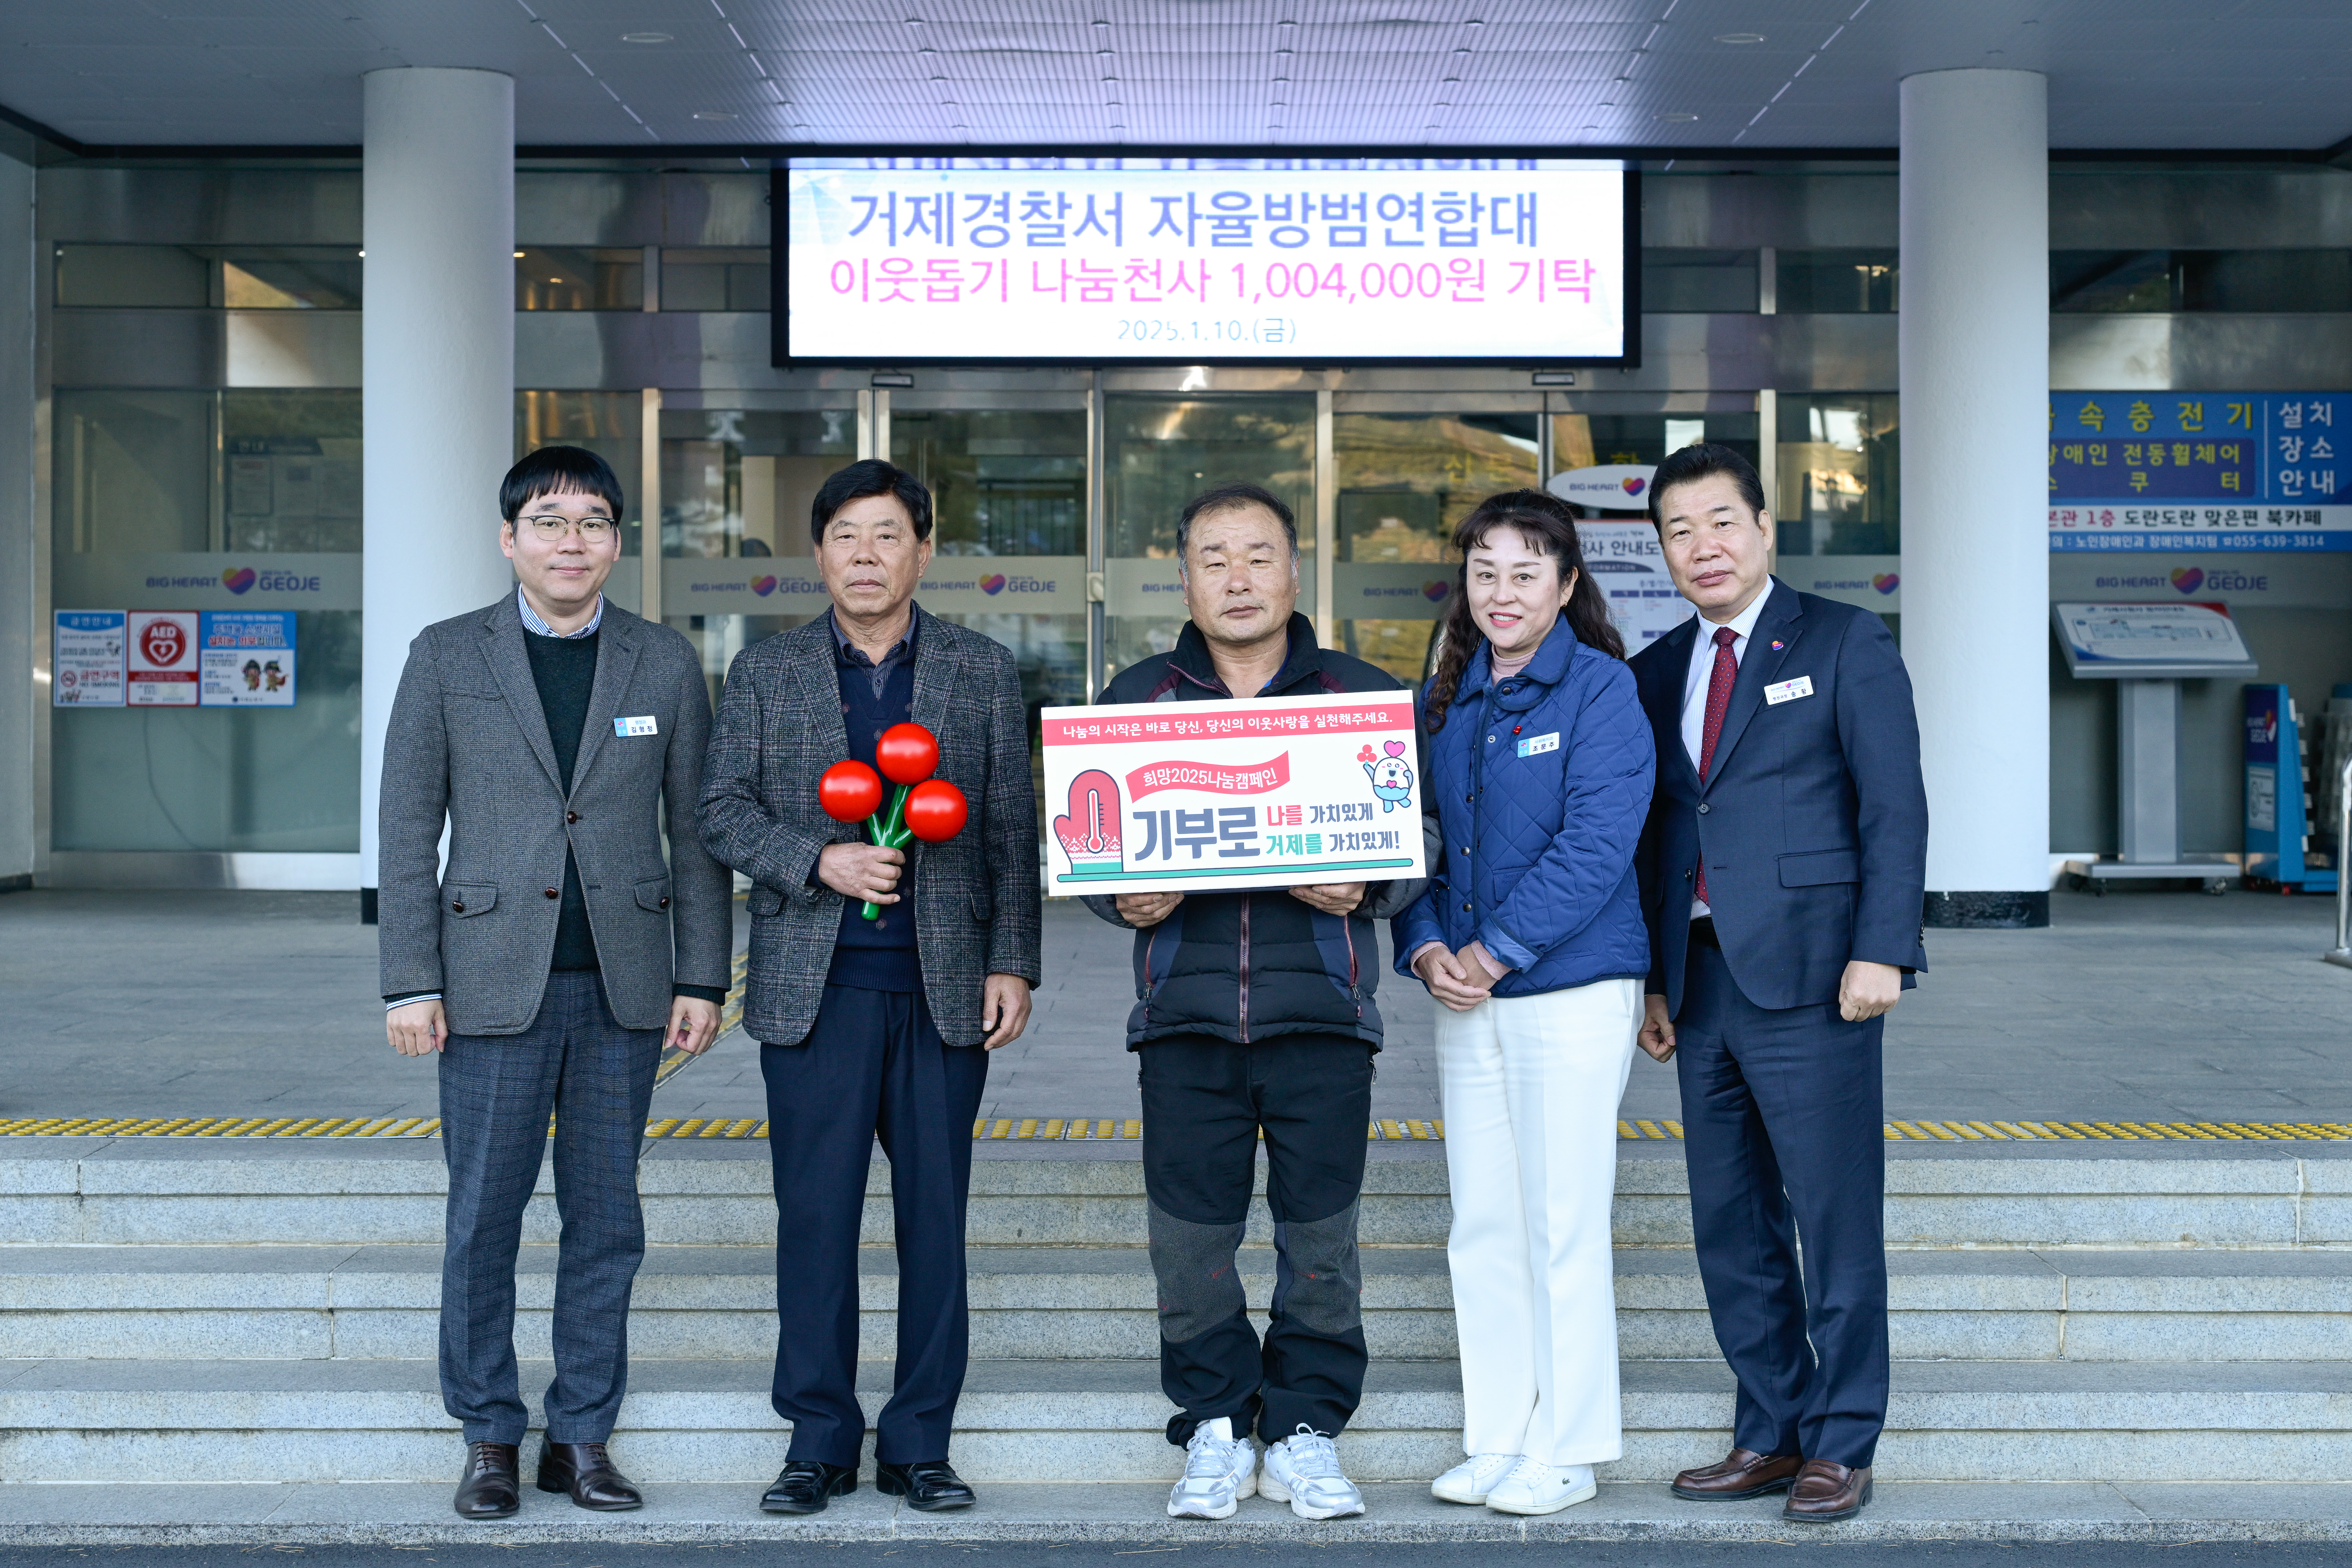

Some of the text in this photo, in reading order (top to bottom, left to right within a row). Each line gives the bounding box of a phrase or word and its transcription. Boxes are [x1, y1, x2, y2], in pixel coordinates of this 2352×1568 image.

[849, 191, 1537, 248] 거제경찰서 자율방범연합대
[830, 257, 1596, 304] 이웃돕기 나눔천사 1,004,000원 기탁
[1118, 318, 1296, 344] 2025.1.10.(금)
[2049, 400, 2252, 432] 속충전기
[2279, 401, 2332, 428] 설치
[2123, 443, 2239, 466] 전동휠체어
[2279, 435, 2334, 463] 장소
[1569, 483, 1619, 491] BIG HEART
[2279, 469, 2335, 496] 안내
[2087, 509, 2115, 527] 1층
[2124, 510, 2196, 527] 도란도란
[2205, 509, 2259, 527] 맞은편
[2267, 509, 2321, 527] 북카페
[1611, 540, 1660, 556] 안내도
[2049, 535, 2063, 548] 의
[146, 577, 217, 588] BIG HEART
[259, 576, 321, 591] GEOJE
[691, 582, 747, 592] BIG HEART
[779, 581, 827, 594] GEOJE
[920, 581, 976, 590] BIG HEART
[1008, 580, 1056, 593] GEOJE
[1142, 583, 1160, 592] BIG
[2095, 576, 2166, 588] BIG HEART
[2207, 576, 2268, 591] GEOJE
[150, 626, 177, 639] AED
[1063, 712, 1393, 739] 나눔의 시작은 바로 당신, 당신의 이웃사랑을 실천해주세요.
[1143, 767, 1278, 790] 희망2025나눔캠페인
[1267, 803, 1373, 826] 나를 가치있게
[1132, 806, 1260, 861] 기부로
[1266, 831, 1400, 856] 거제를 가치있게!
